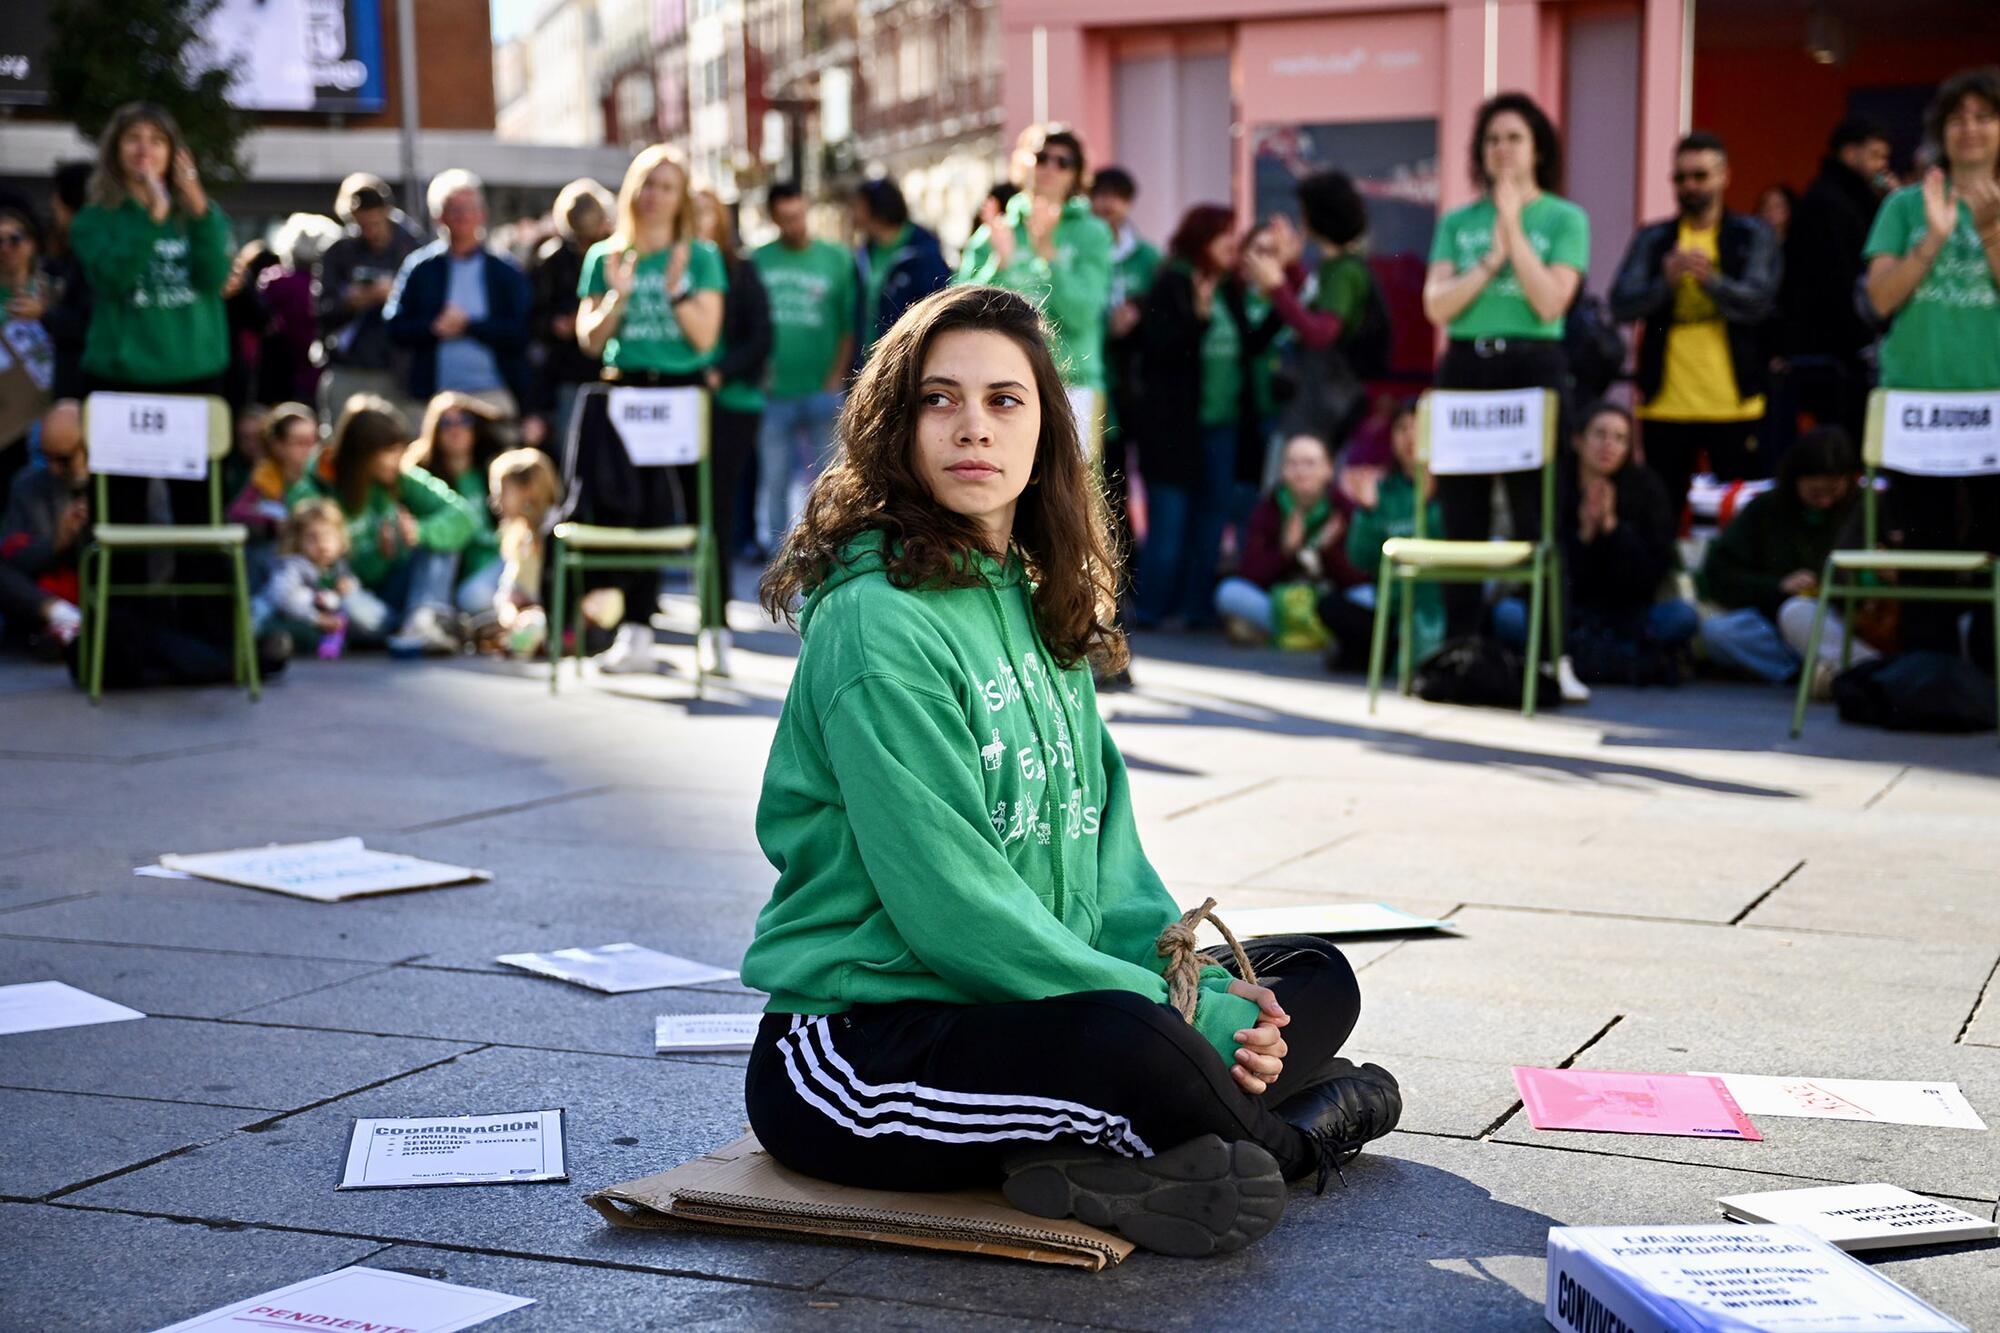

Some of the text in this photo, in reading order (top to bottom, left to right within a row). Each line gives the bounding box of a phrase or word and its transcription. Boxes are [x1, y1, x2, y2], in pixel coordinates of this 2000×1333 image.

[1820, 1203, 1939, 1217] PROFESIONAL
[1890, 1216, 1974, 1228] ESTUDIAR
[1623, 1234, 1771, 1244] EVALUACIONES
[1681, 1266, 1830, 1276] AUTORIZACIONES
[1693, 1276, 1812, 1287] ENTREVISTAS
[1707, 1287, 1791, 1297] PRUEBAS
[1721, 1297, 1818, 1308] INFORMES
